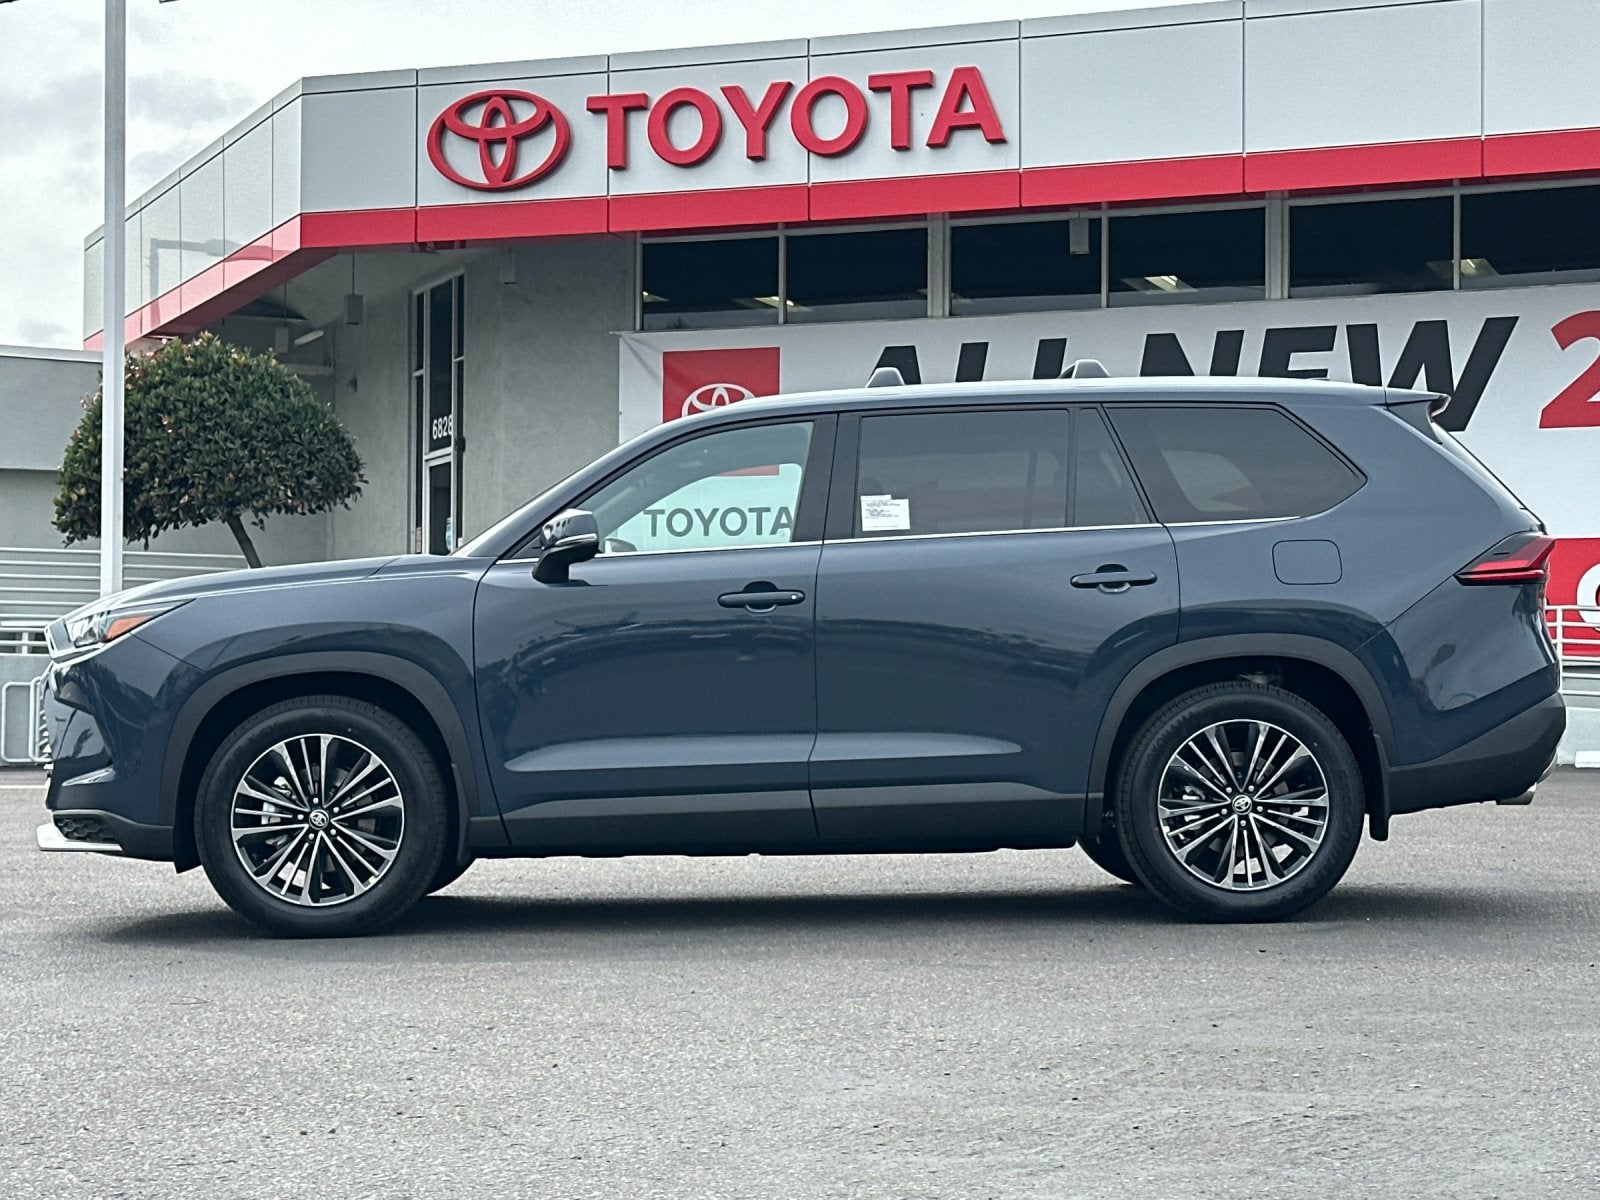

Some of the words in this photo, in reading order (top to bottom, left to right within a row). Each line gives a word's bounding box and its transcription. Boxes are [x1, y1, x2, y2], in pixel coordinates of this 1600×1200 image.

[587, 66, 1007, 170] TOYOTA
[432, 414, 453, 440] 6828
[643, 506, 793, 537] TOYOTA
